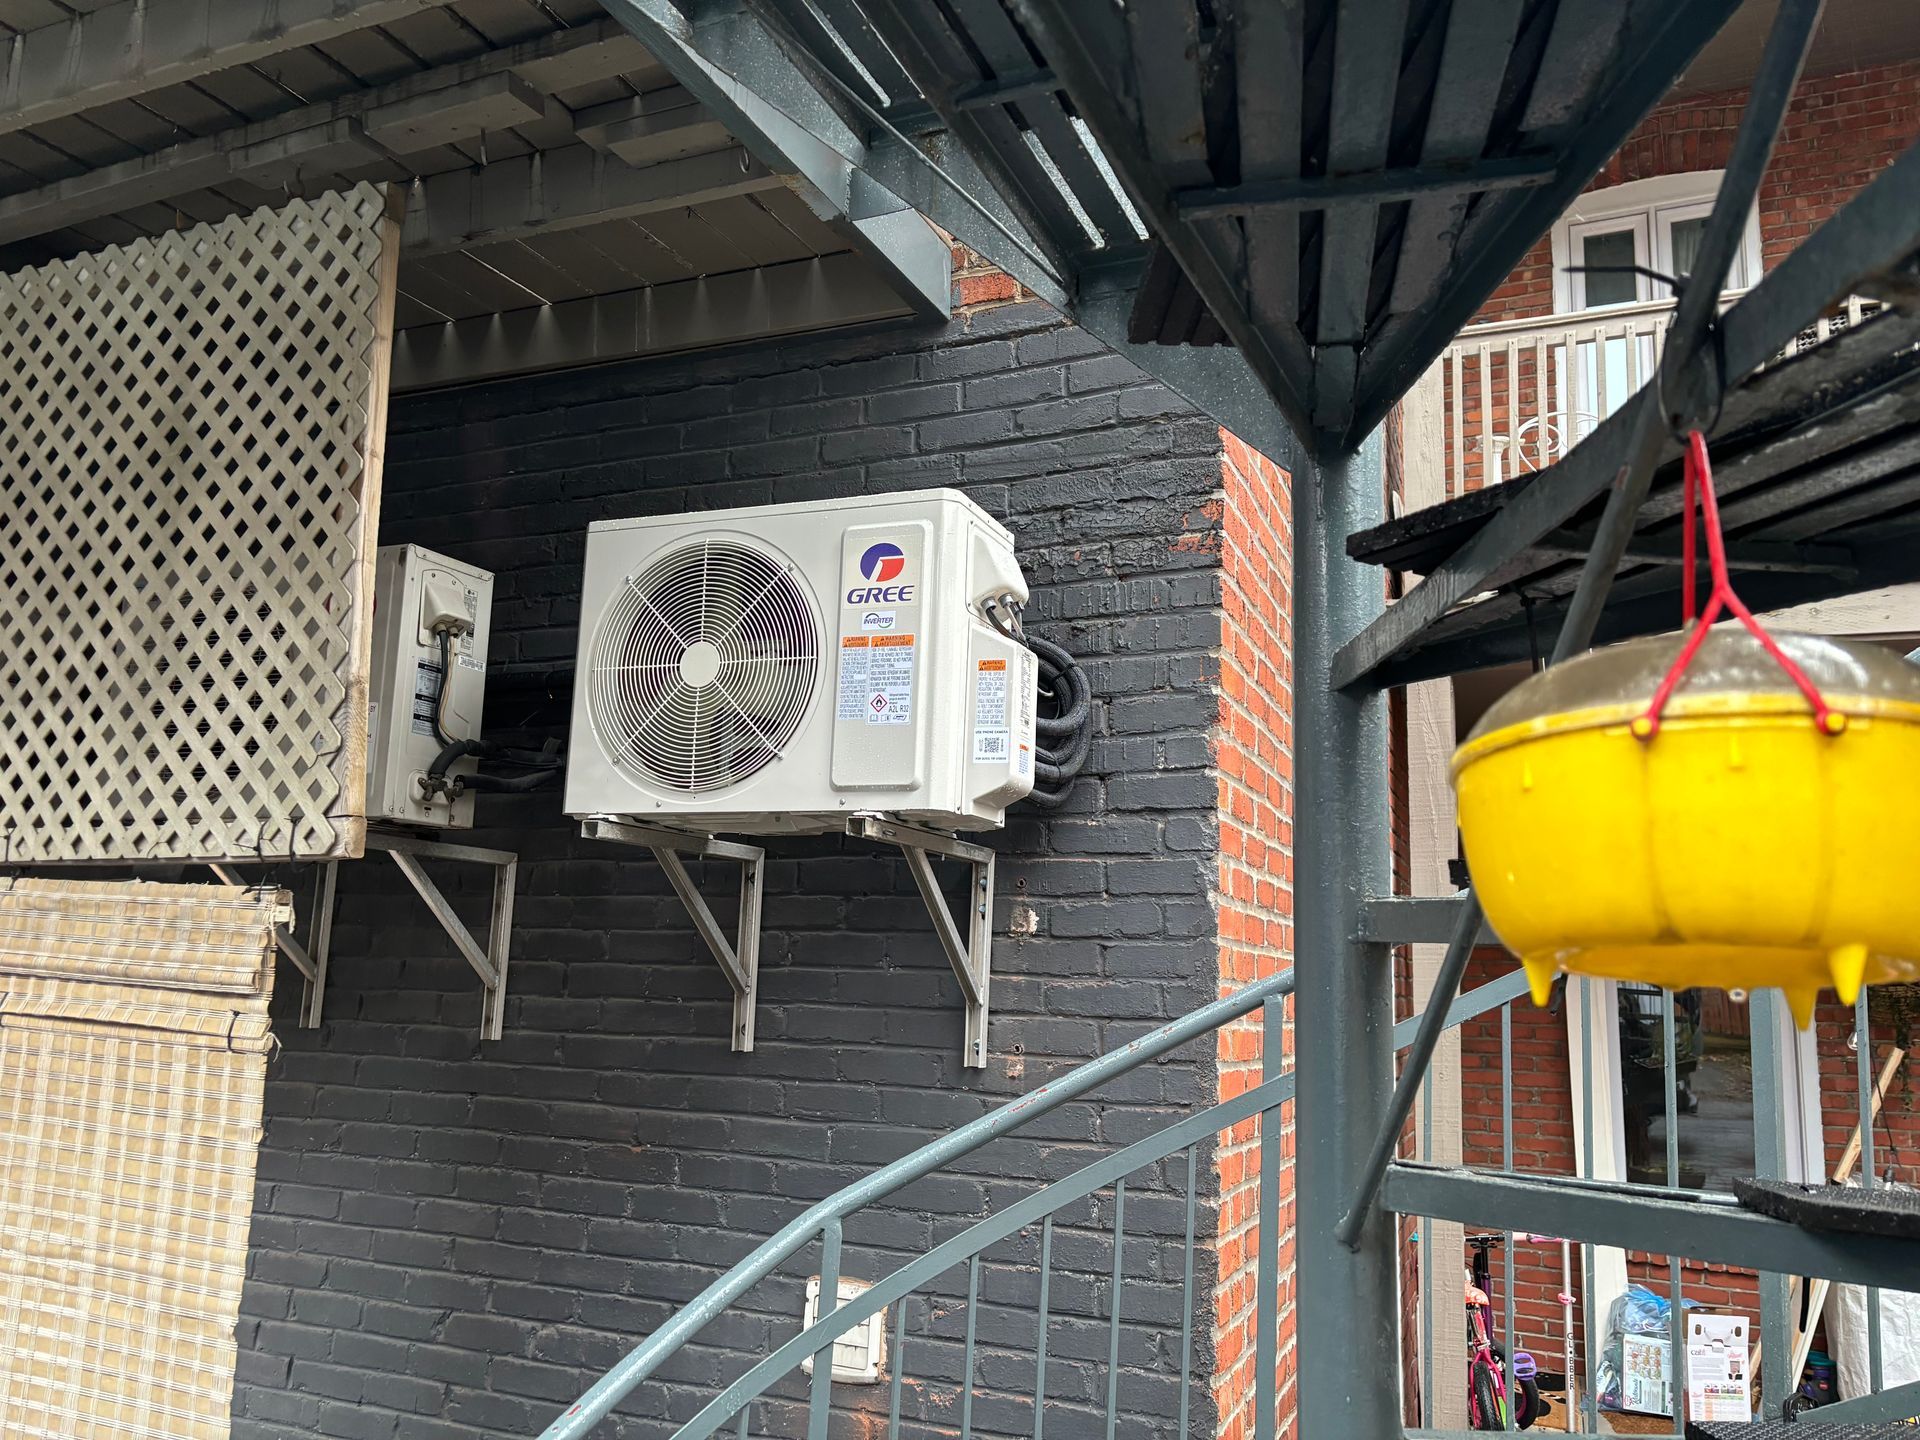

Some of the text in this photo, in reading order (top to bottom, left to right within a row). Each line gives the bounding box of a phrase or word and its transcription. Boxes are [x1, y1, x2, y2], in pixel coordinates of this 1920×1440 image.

[847, 585, 915, 604] GREE
[864, 616, 894, 625] INVERTER
[900, 704, 910, 713] R32
